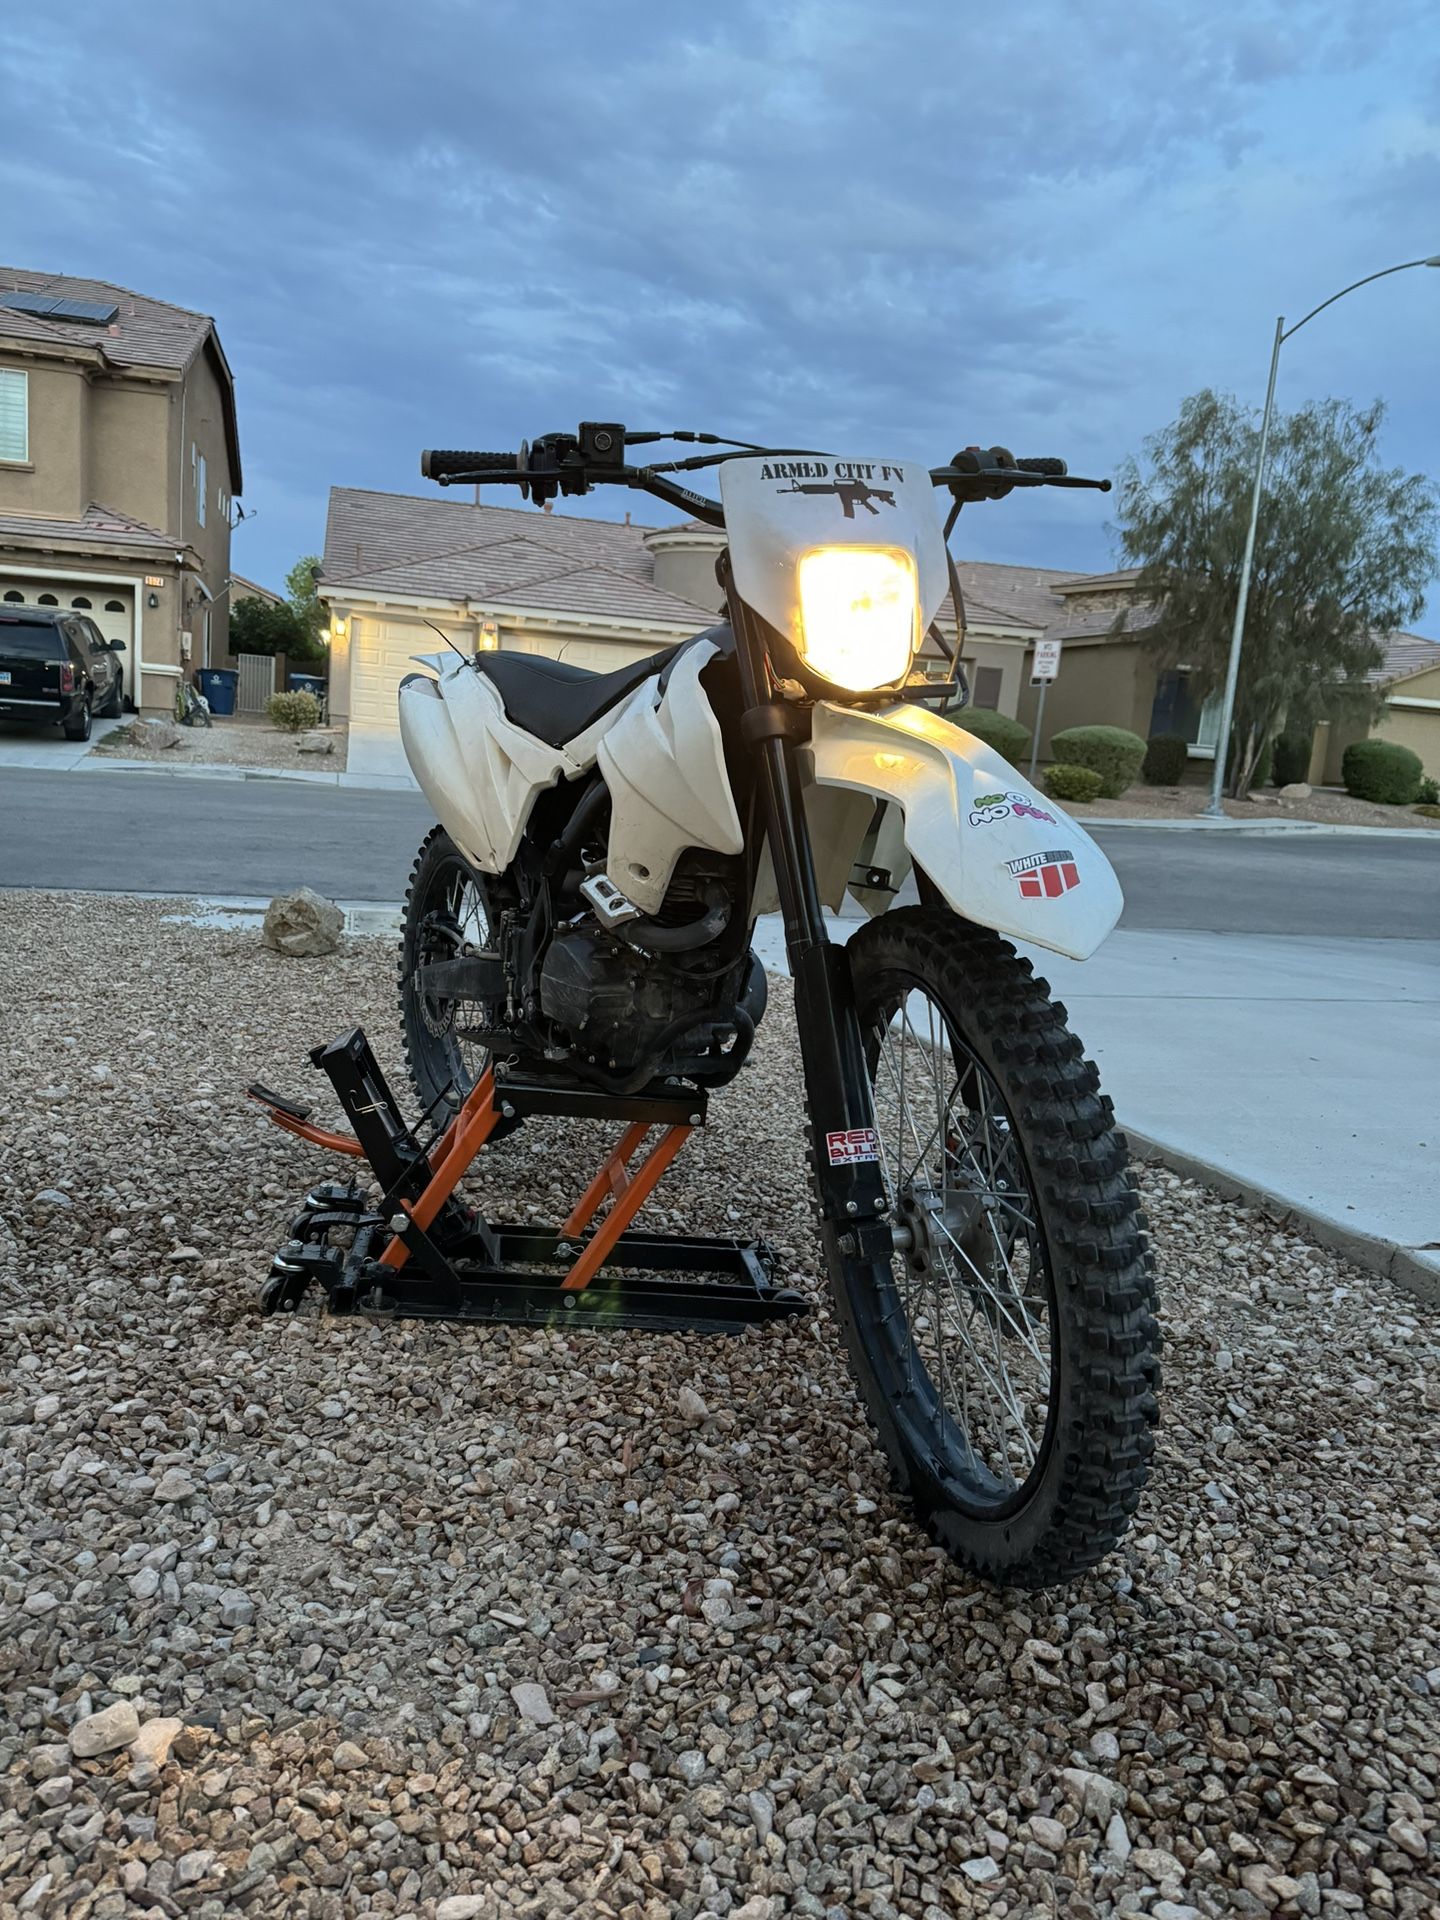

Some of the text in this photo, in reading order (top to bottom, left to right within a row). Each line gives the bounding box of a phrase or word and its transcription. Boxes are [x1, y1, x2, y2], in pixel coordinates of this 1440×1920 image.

[760, 463, 828, 480] ARMED
[969, 805, 1010, 826] NO
[827, 1130, 876, 1147] RED
[830, 1143, 878, 1158] BULL
